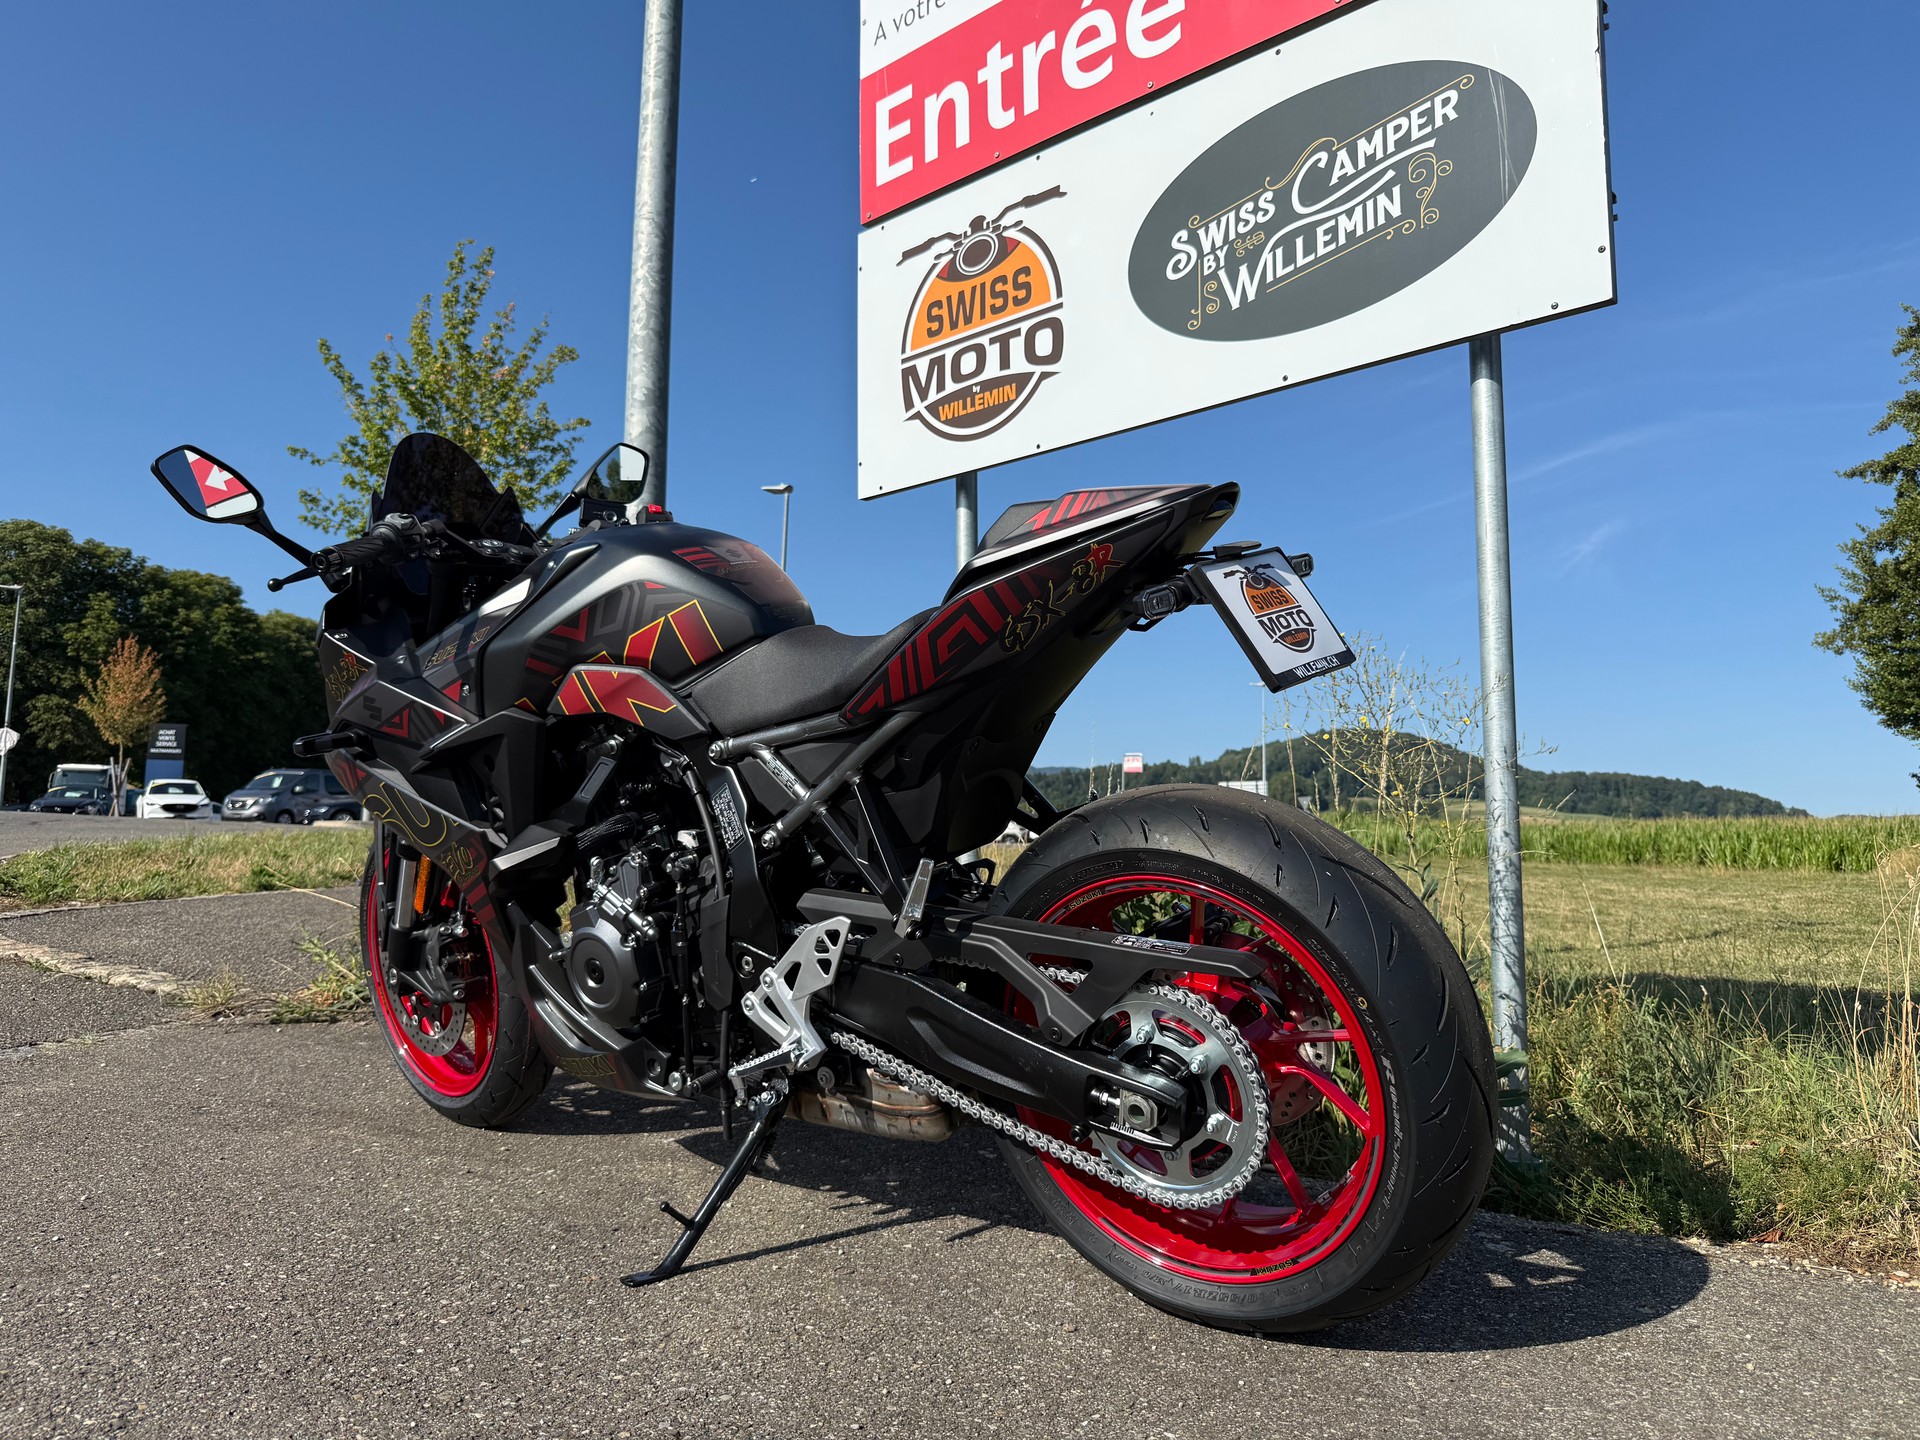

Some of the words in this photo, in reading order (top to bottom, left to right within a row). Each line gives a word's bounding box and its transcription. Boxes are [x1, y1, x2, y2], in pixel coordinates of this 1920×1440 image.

[875, 0, 1186, 187] Entrée
[1166, 190, 1276, 281] SWISS
[1291, 89, 1459, 215] CAMPER
[1217, 175, 1402, 311] WILLEMIN
[1203, 245, 1229, 276] BY
[926, 265, 1032, 339] SWISS
[901, 316, 1064, 414] MOTO
[938, 383, 1017, 422] WILLEMIN
[972, 384, 981, 393] by
[1250, 588, 1290, 611] SWISS
[1257, 608, 1315, 641] MOTO
[1284, 631, 1310, 645] WILLEMIN
[1292, 655, 1341, 679] WILLEMIN.CH
[1068, 889, 1103, 911] SUZUKI
[1255, 1259, 1293, 1276] SUZUKI
